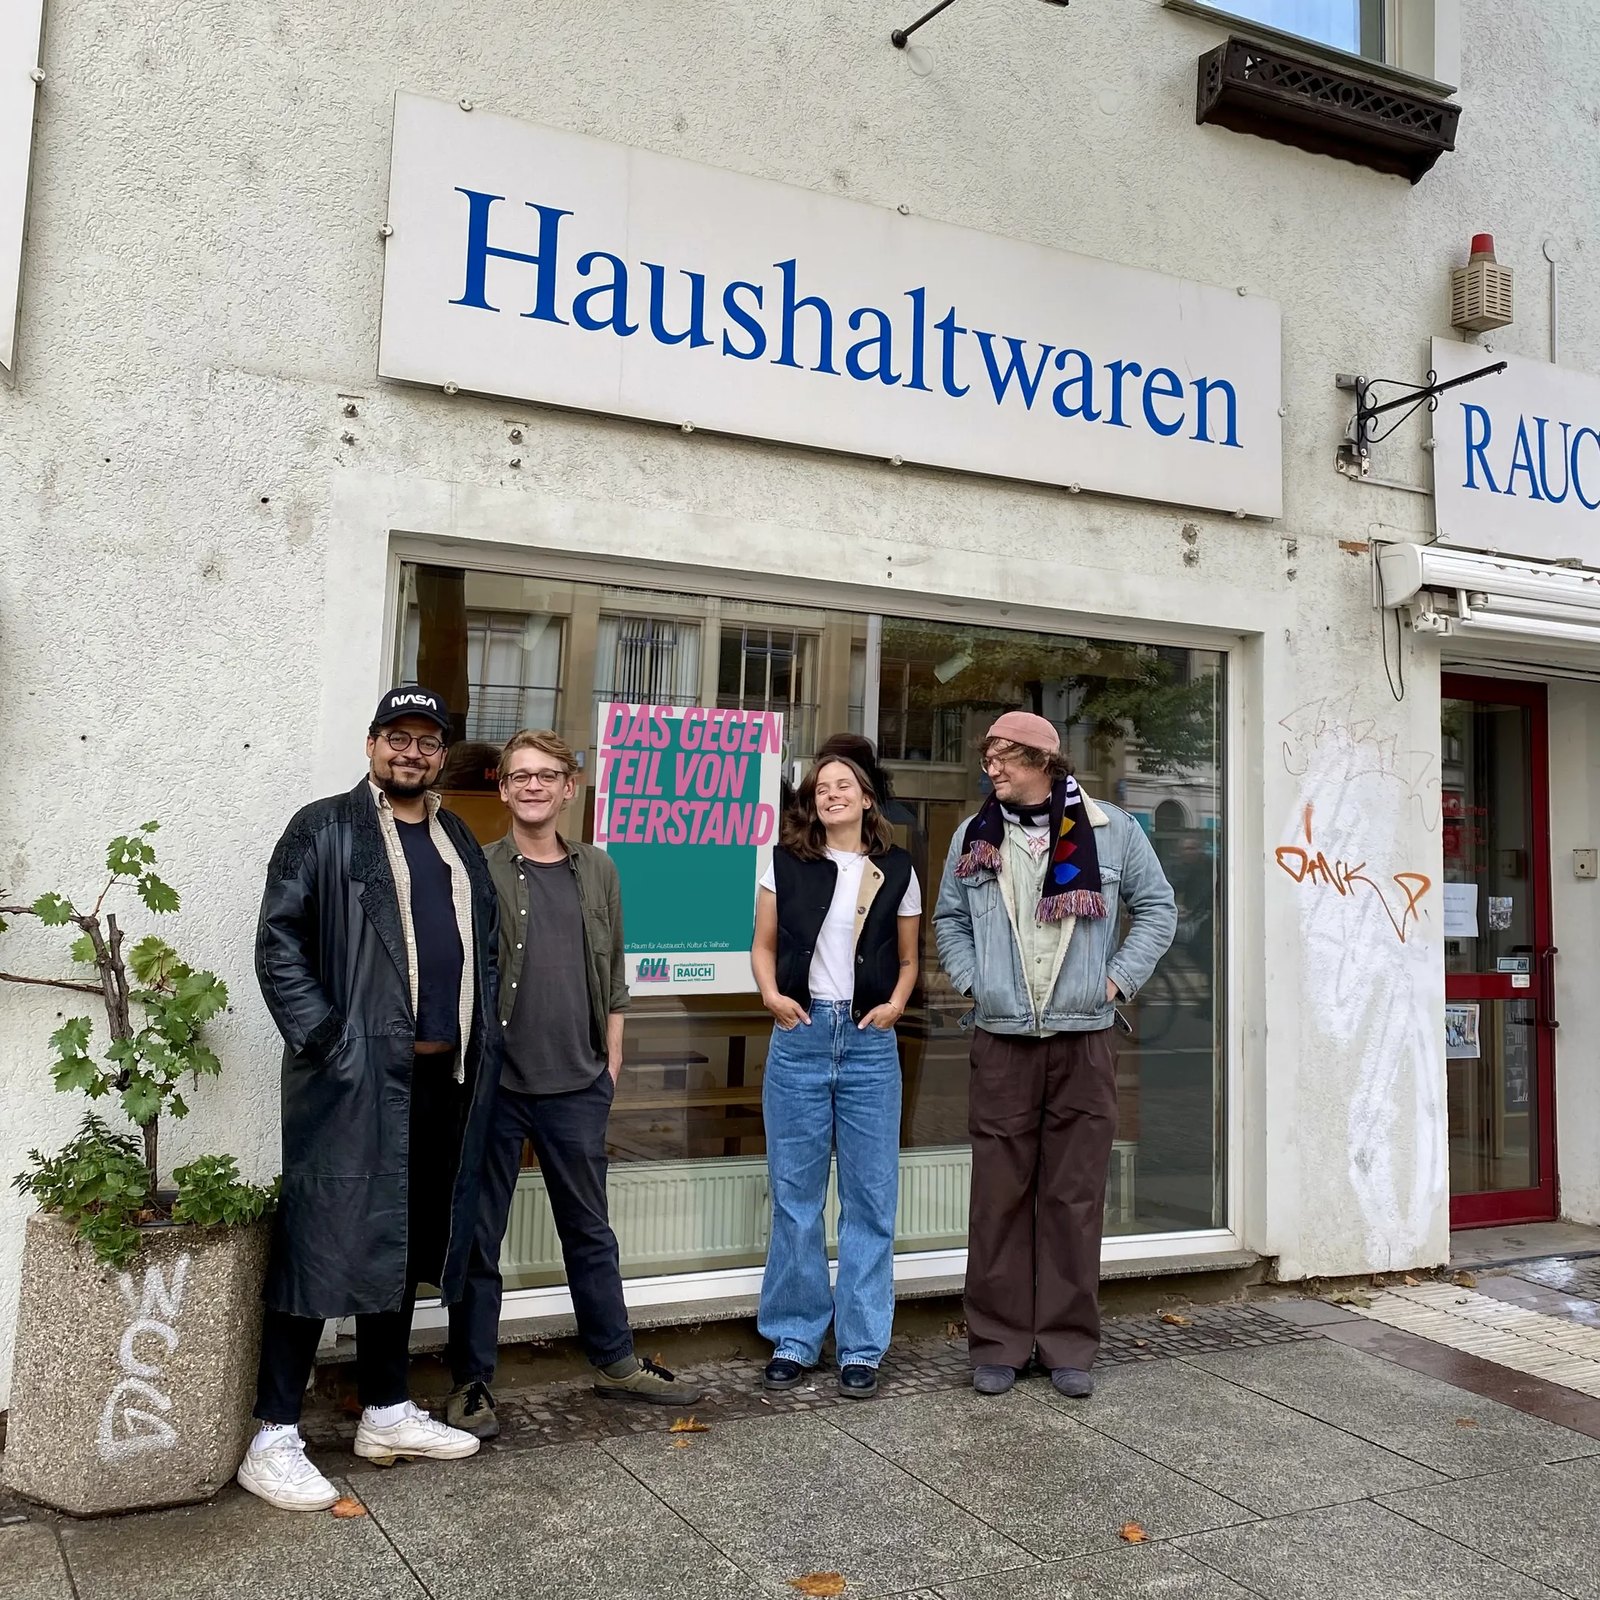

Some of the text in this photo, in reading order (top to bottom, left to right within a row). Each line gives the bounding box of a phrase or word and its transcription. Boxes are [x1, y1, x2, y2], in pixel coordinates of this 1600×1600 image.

[449, 187, 1244, 448] Haushaltwaren
[1459, 403, 1600, 510] RAUC
[391, 694, 437, 711] NASA
[602, 702, 782, 754] DAS GEGEN
[599, 748, 748, 798] TEIL VON
[595, 797, 775, 846] LEERSTAND
[677, 967, 712, 977] RAUCH
